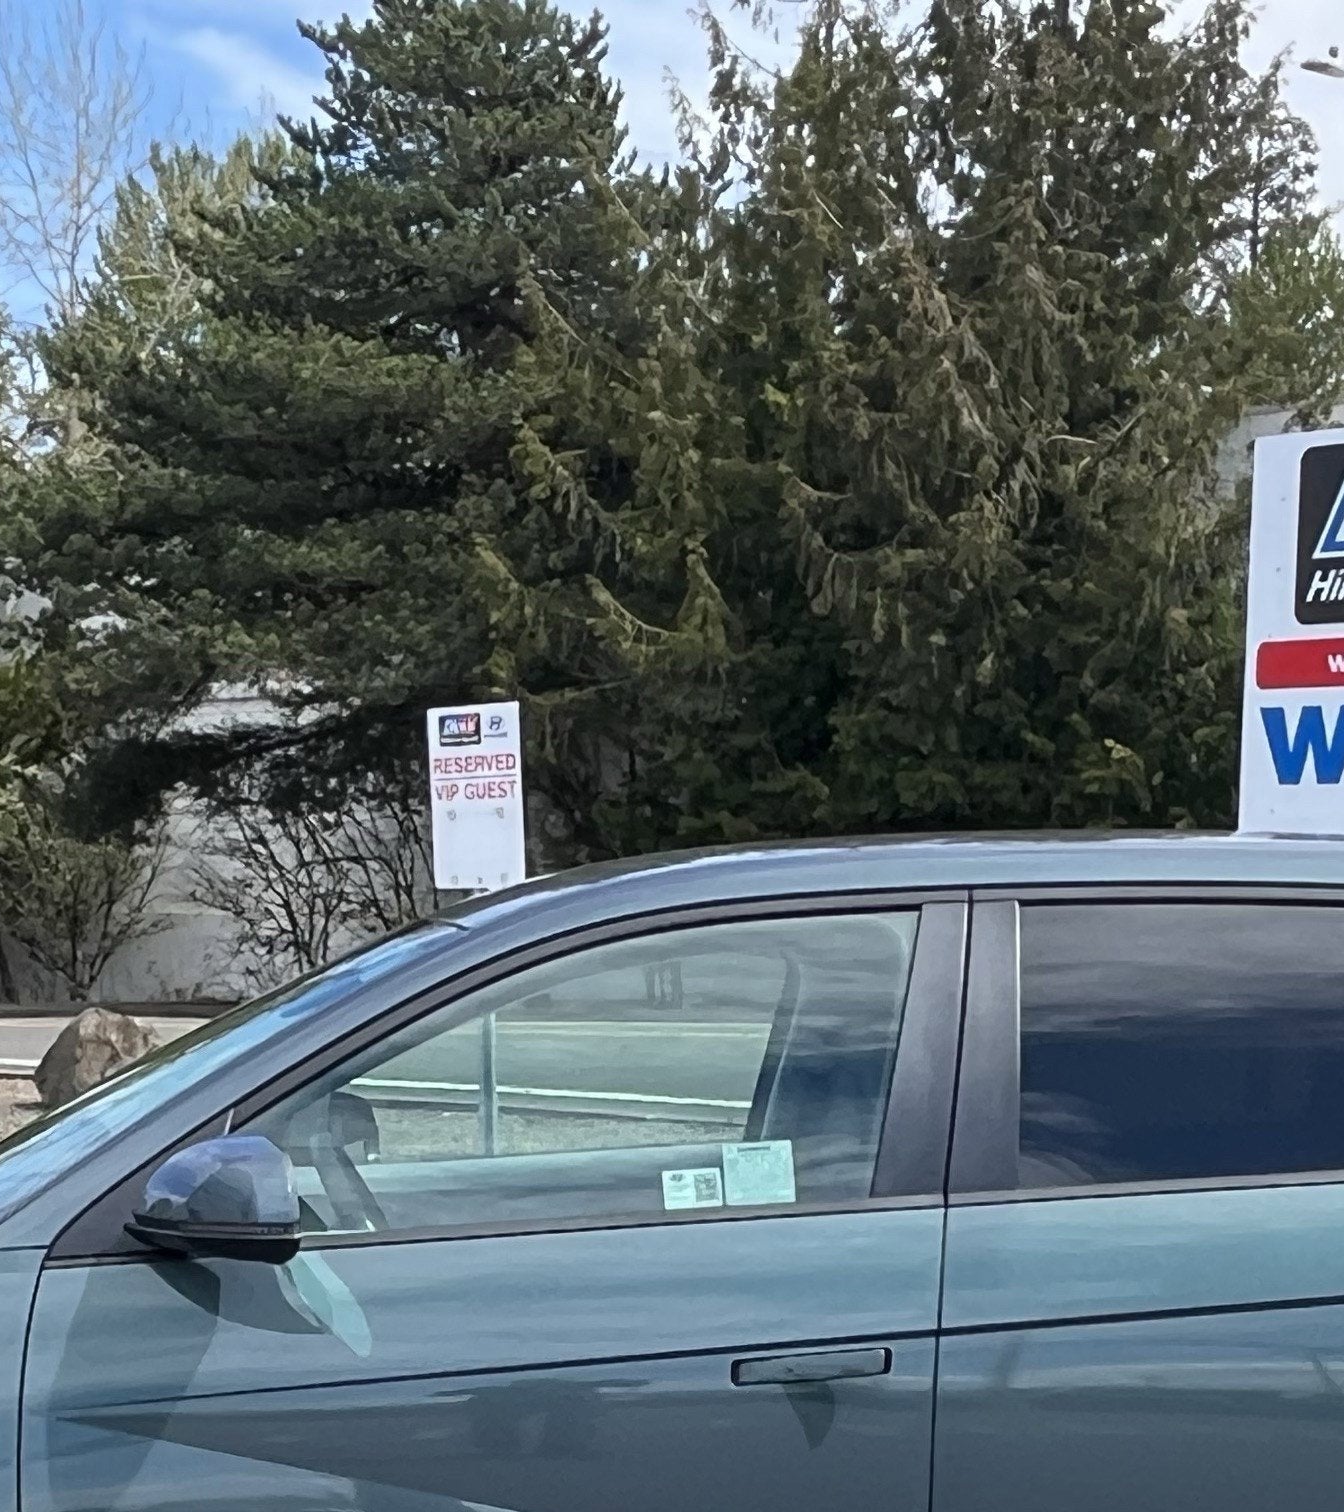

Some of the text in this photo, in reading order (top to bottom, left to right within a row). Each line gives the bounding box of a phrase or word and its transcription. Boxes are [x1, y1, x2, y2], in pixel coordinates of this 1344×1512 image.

[433, 753, 516, 774] RESERVED
[435, 780, 517, 801] VIP GUEST
